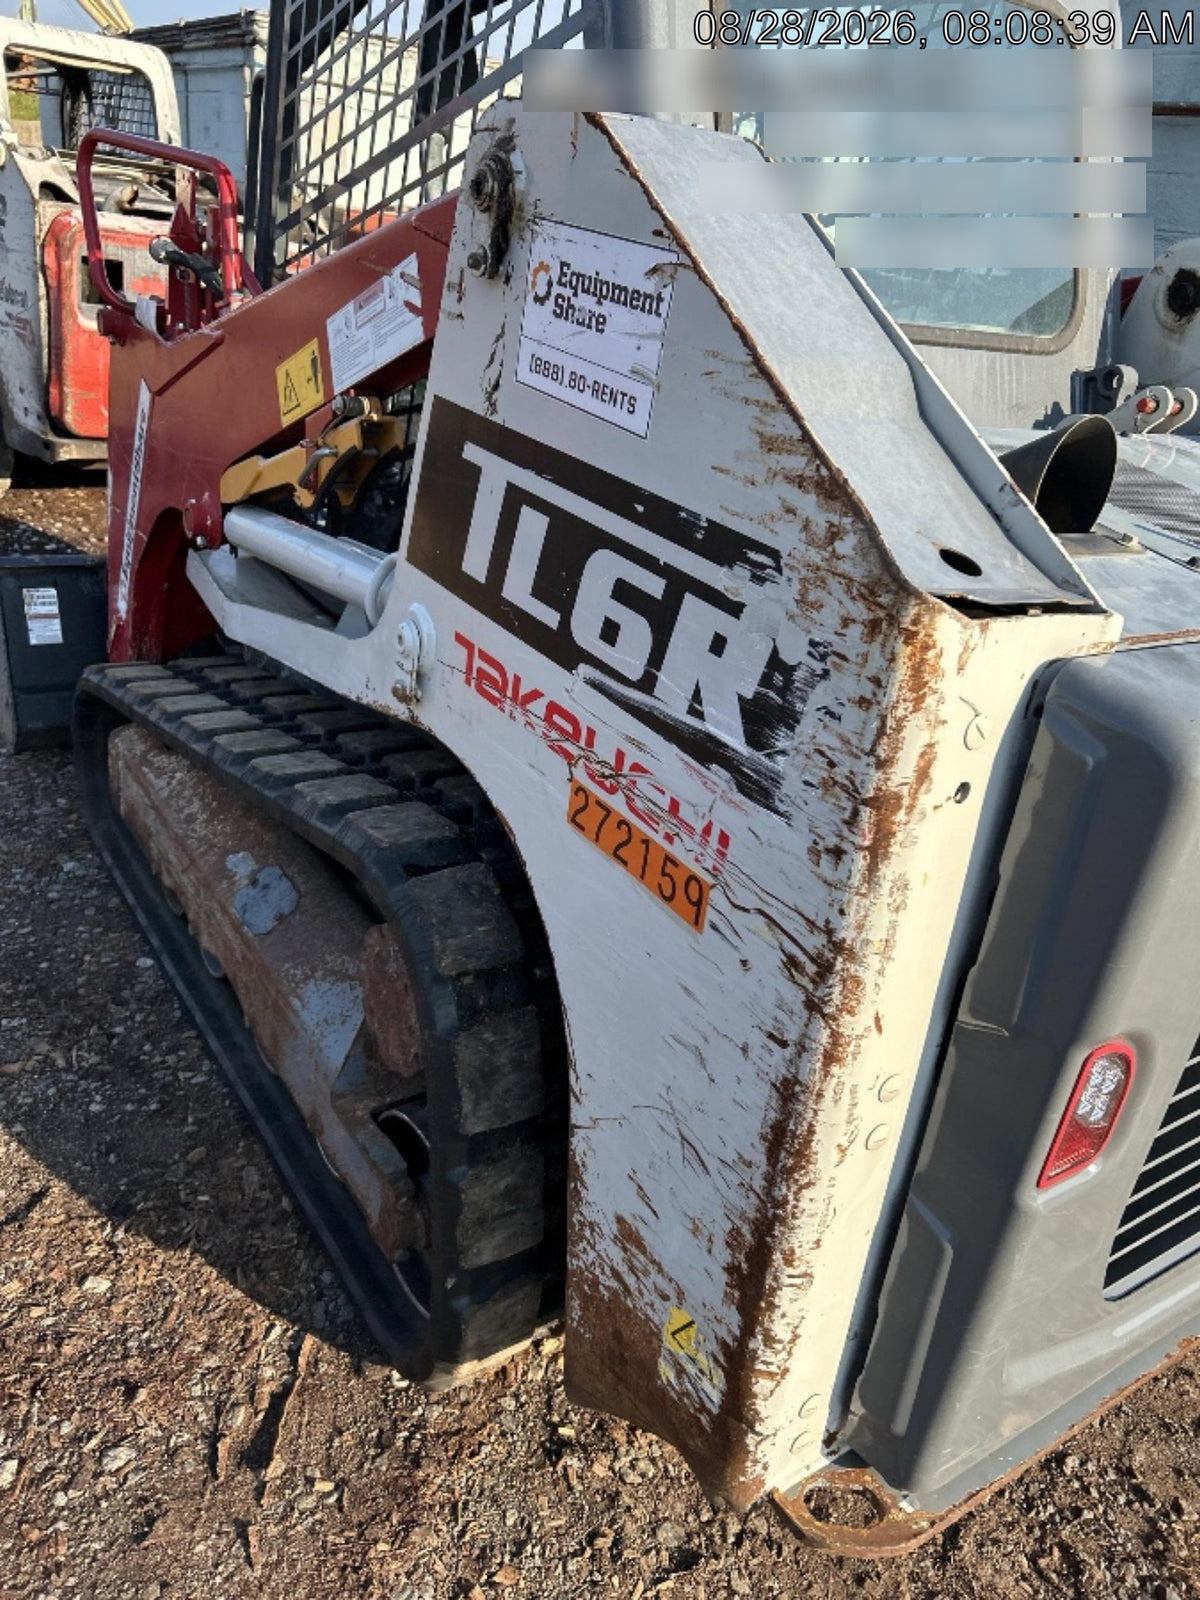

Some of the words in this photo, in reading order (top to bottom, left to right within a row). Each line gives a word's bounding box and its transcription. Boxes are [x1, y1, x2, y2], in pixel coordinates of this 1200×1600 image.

[552, 292, 608, 335] Share
[556, 260, 665, 318] Equipment
[528, 352, 638, 416] (888).80-RENTS
[461, 440, 778, 752] TL6R
[569, 787, 704, 926] 272159
